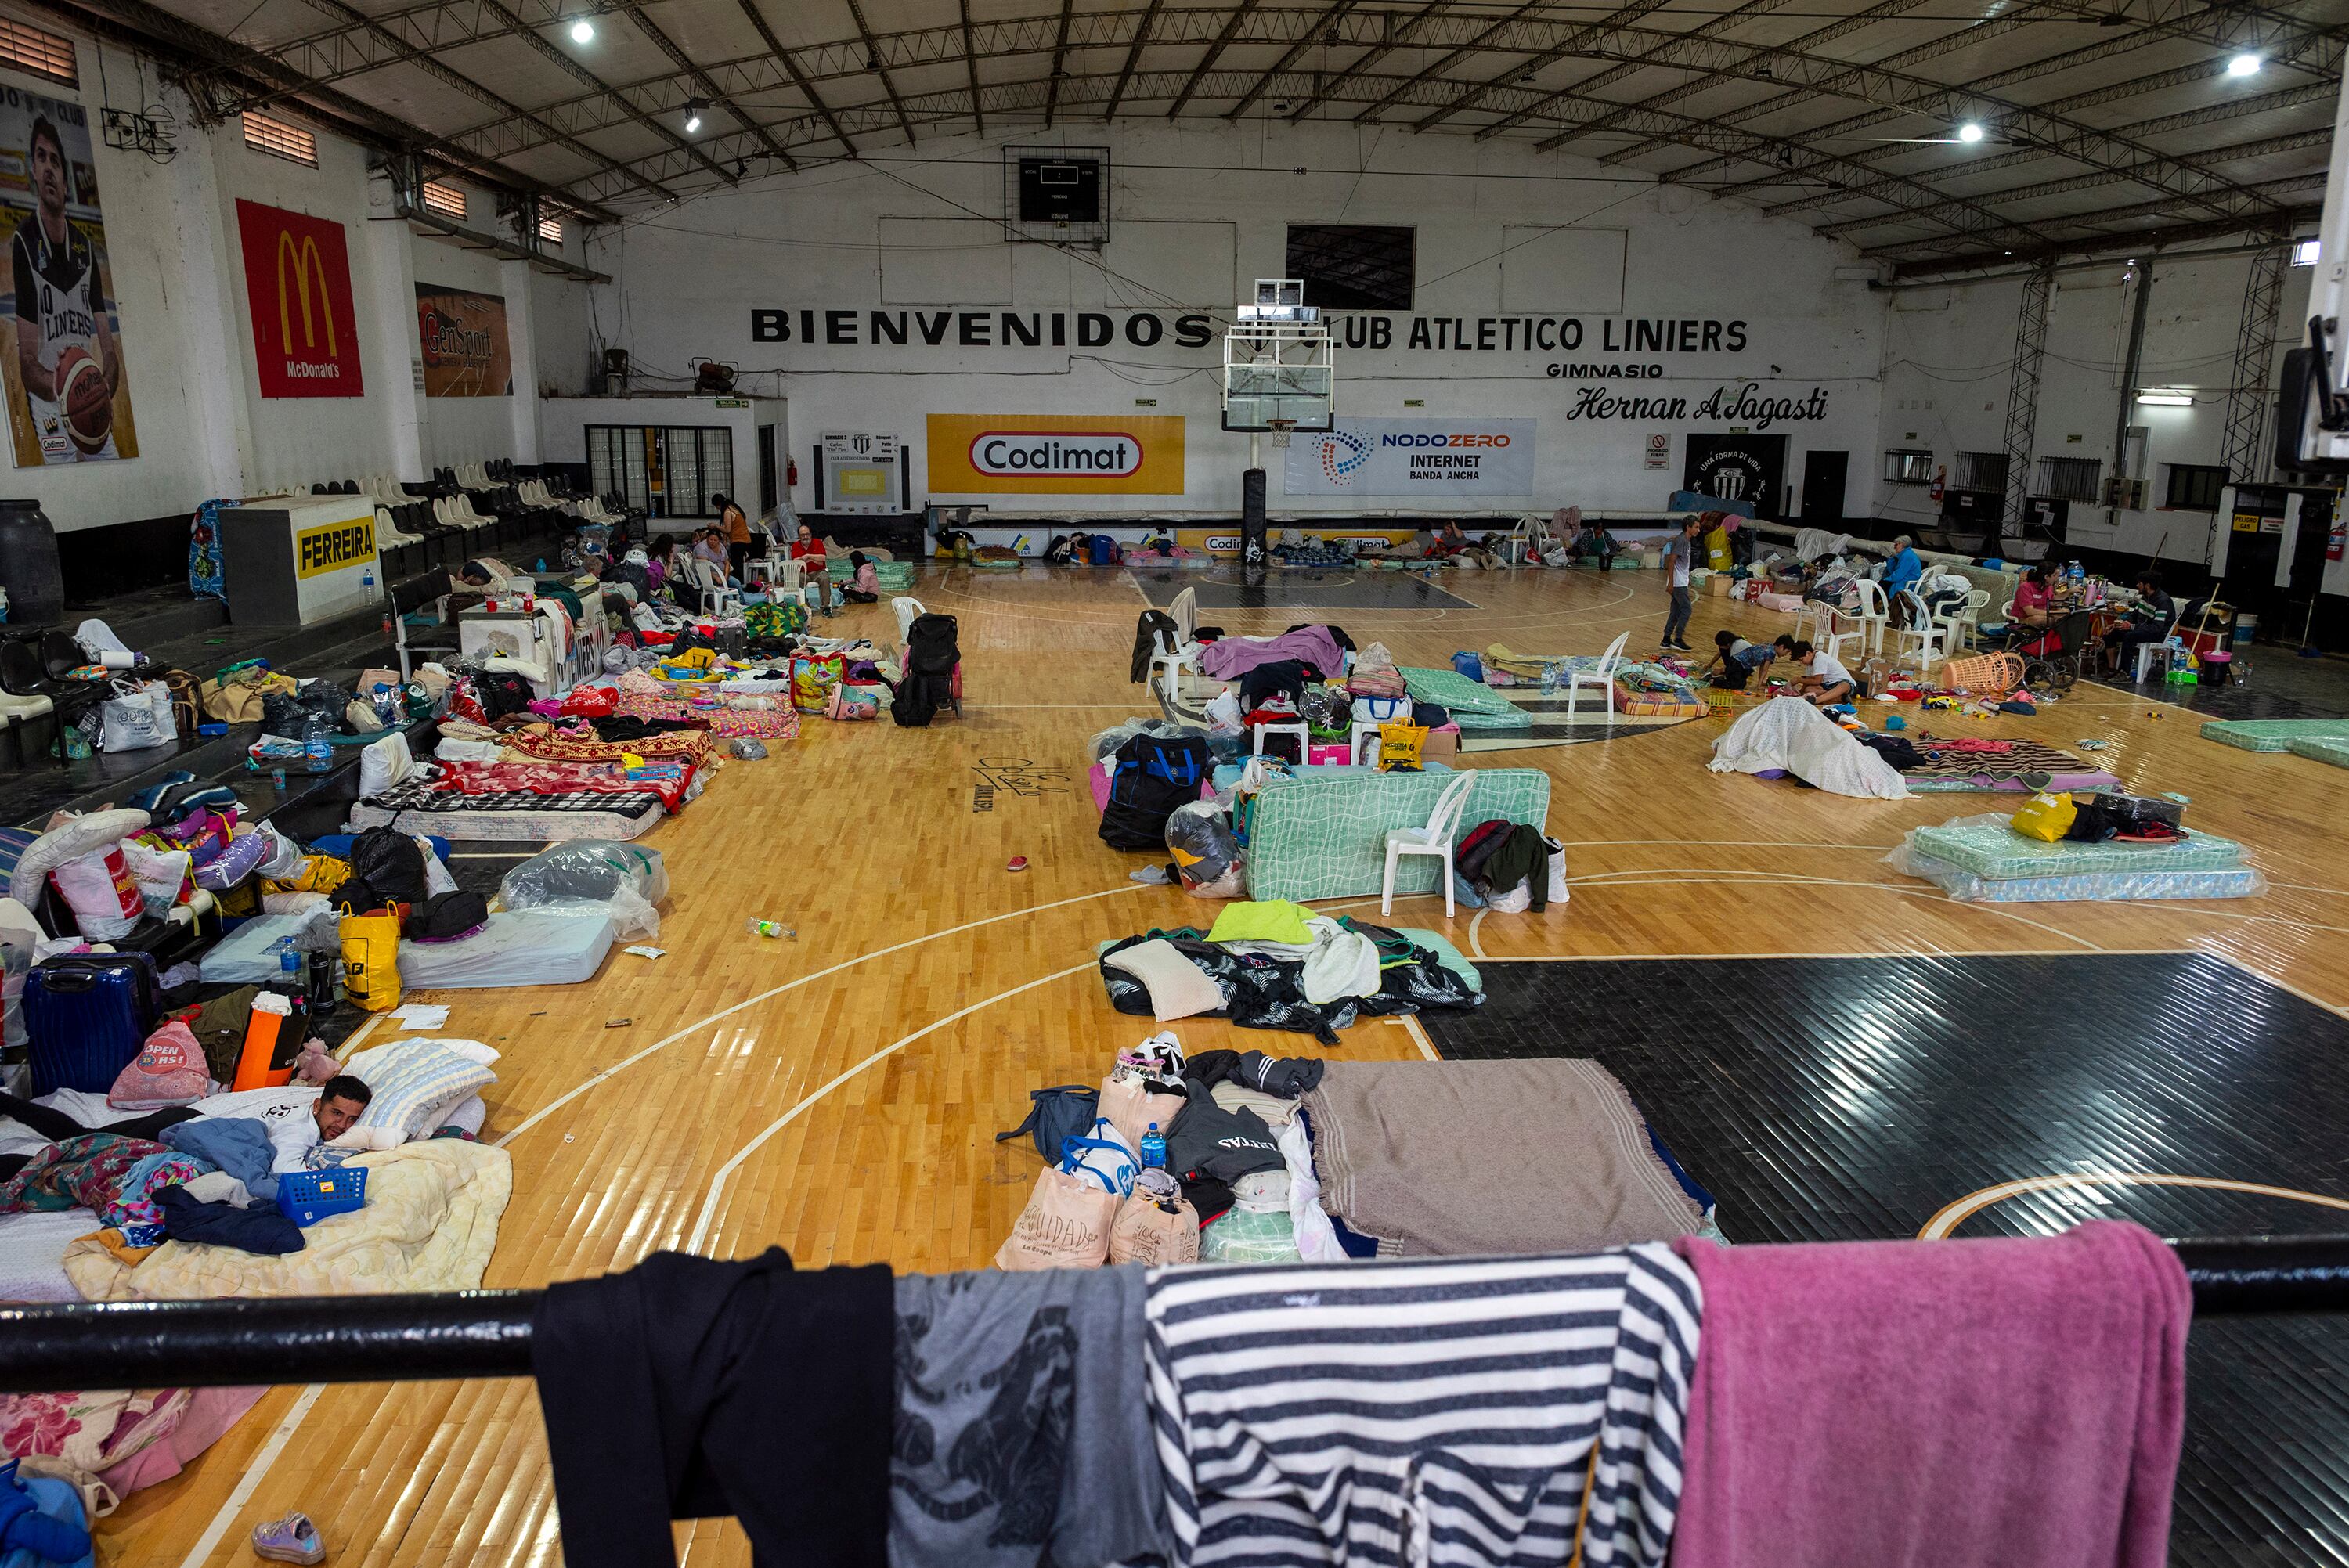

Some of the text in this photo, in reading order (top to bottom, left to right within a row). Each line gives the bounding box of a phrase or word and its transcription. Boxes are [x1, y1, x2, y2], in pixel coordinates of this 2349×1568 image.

[56, 102, 85, 127] CLUB
[425, 312, 493, 369] GenSport
[752, 310, 1211, 347] BIENVENIDOS
[1409, 317, 1583, 351] ATLETICO
[1604, 319, 1748, 352] LINIERS
[287, 361, 340, 378] McDonald's
[1547, 363, 1663, 379] GIMNASIO
[1567, 387, 1687, 420] Hernan
[1382, 434, 1510, 448] NODOZERO
[984, 439, 1126, 470] Codimat
[1410, 455, 1481, 468] INTERNET
[1699, 451, 1762, 473] UNA FORMA DE VIDA
[1409, 471, 1479, 480] BANDA ANCHA
[301, 524, 373, 571] FERREIRA
[143, 1044, 179, 1055] OPEN
